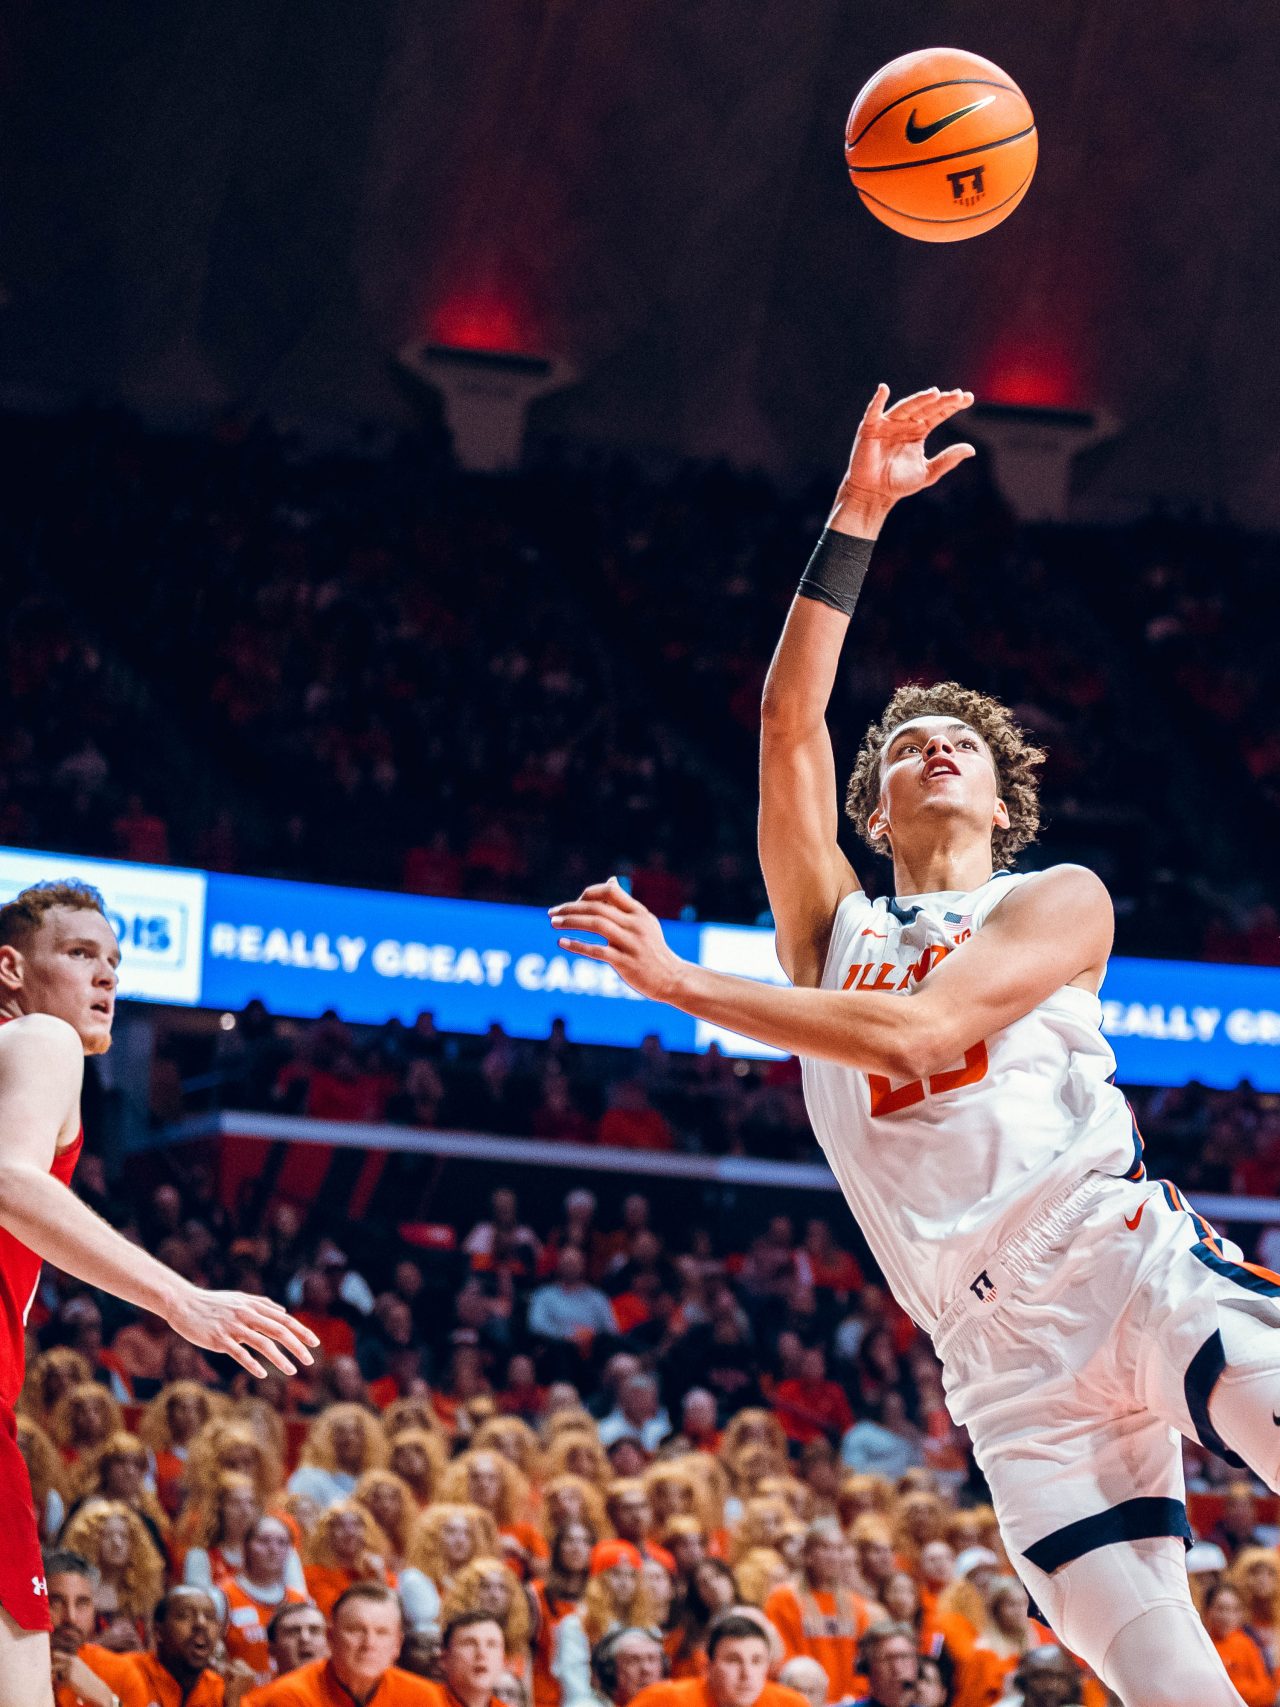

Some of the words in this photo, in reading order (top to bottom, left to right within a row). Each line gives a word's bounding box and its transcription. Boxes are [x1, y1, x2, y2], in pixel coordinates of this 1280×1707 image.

[211, 922, 367, 974] REALLY
[372, 938, 511, 988] GREAT
[1101, 1000, 1221, 1043] EALLY
